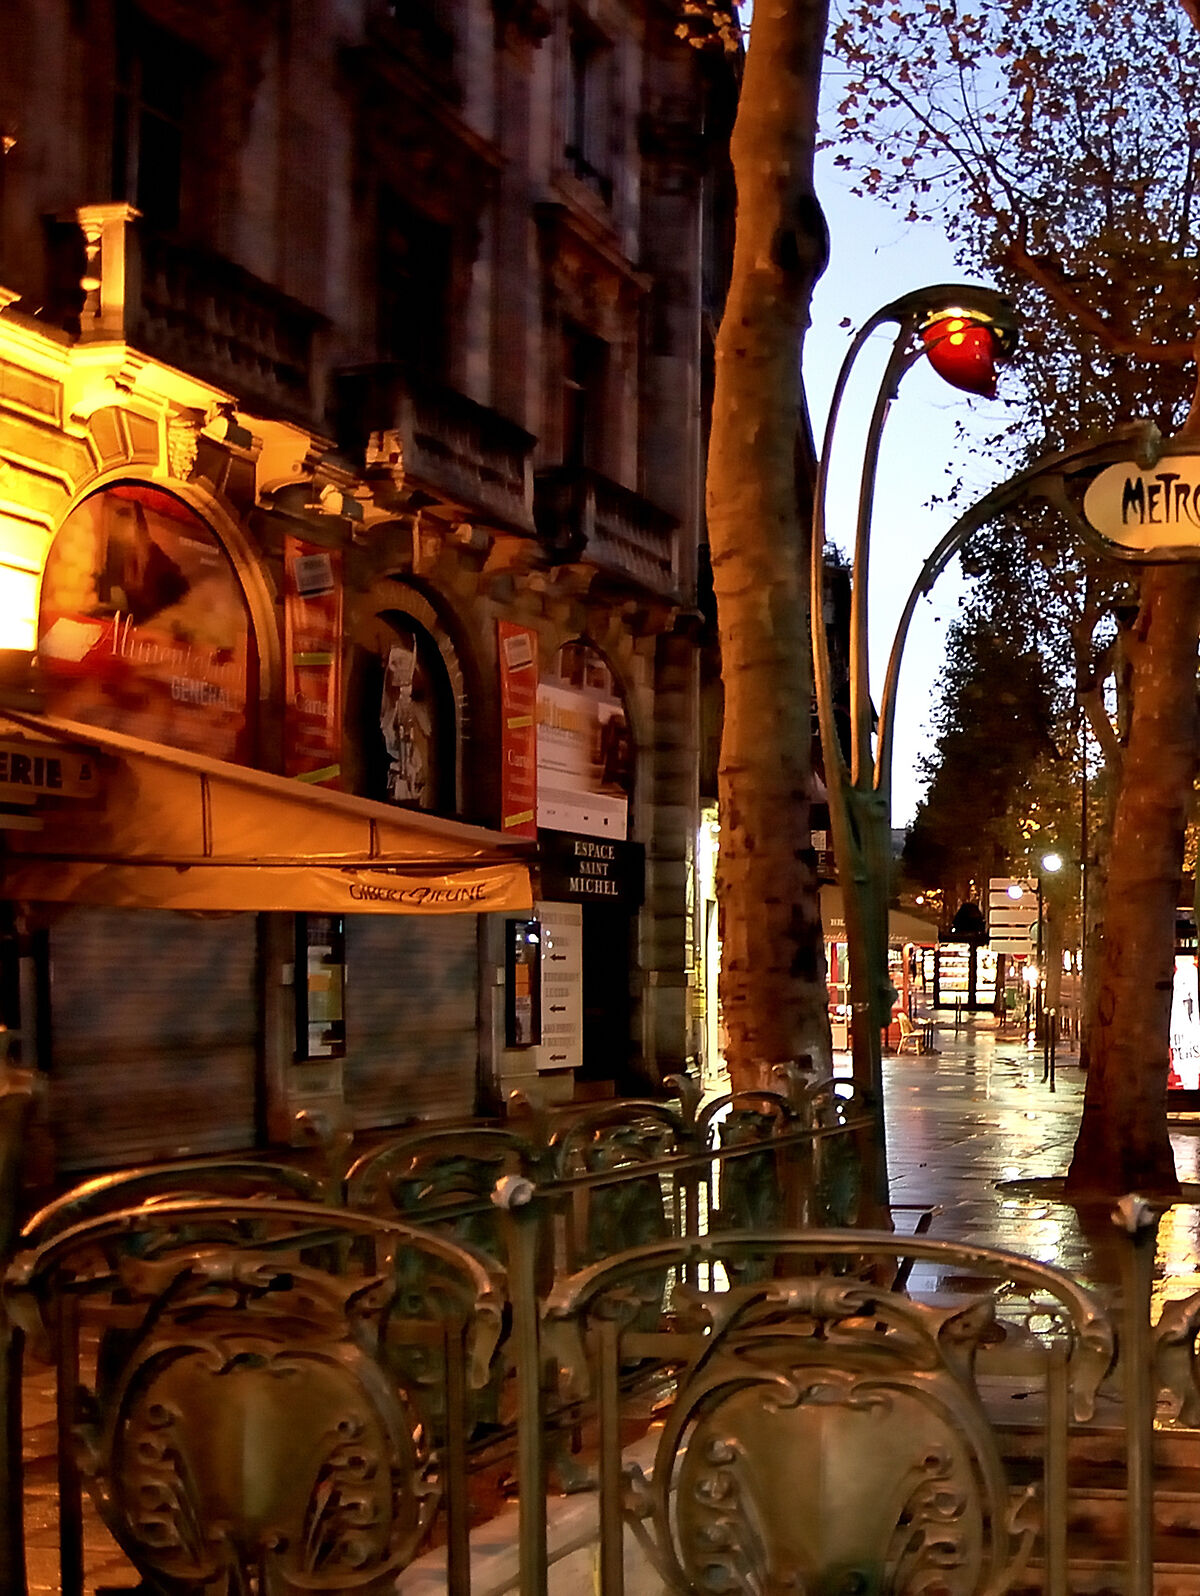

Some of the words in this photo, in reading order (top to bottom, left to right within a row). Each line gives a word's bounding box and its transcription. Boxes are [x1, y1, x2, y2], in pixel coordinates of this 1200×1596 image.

[574, 841, 615, 860] ESPACE
[579, 861, 608, 876] SAINT
[349, 883, 406, 902] GIBERT
[569, 877, 618, 896] MICHEL
